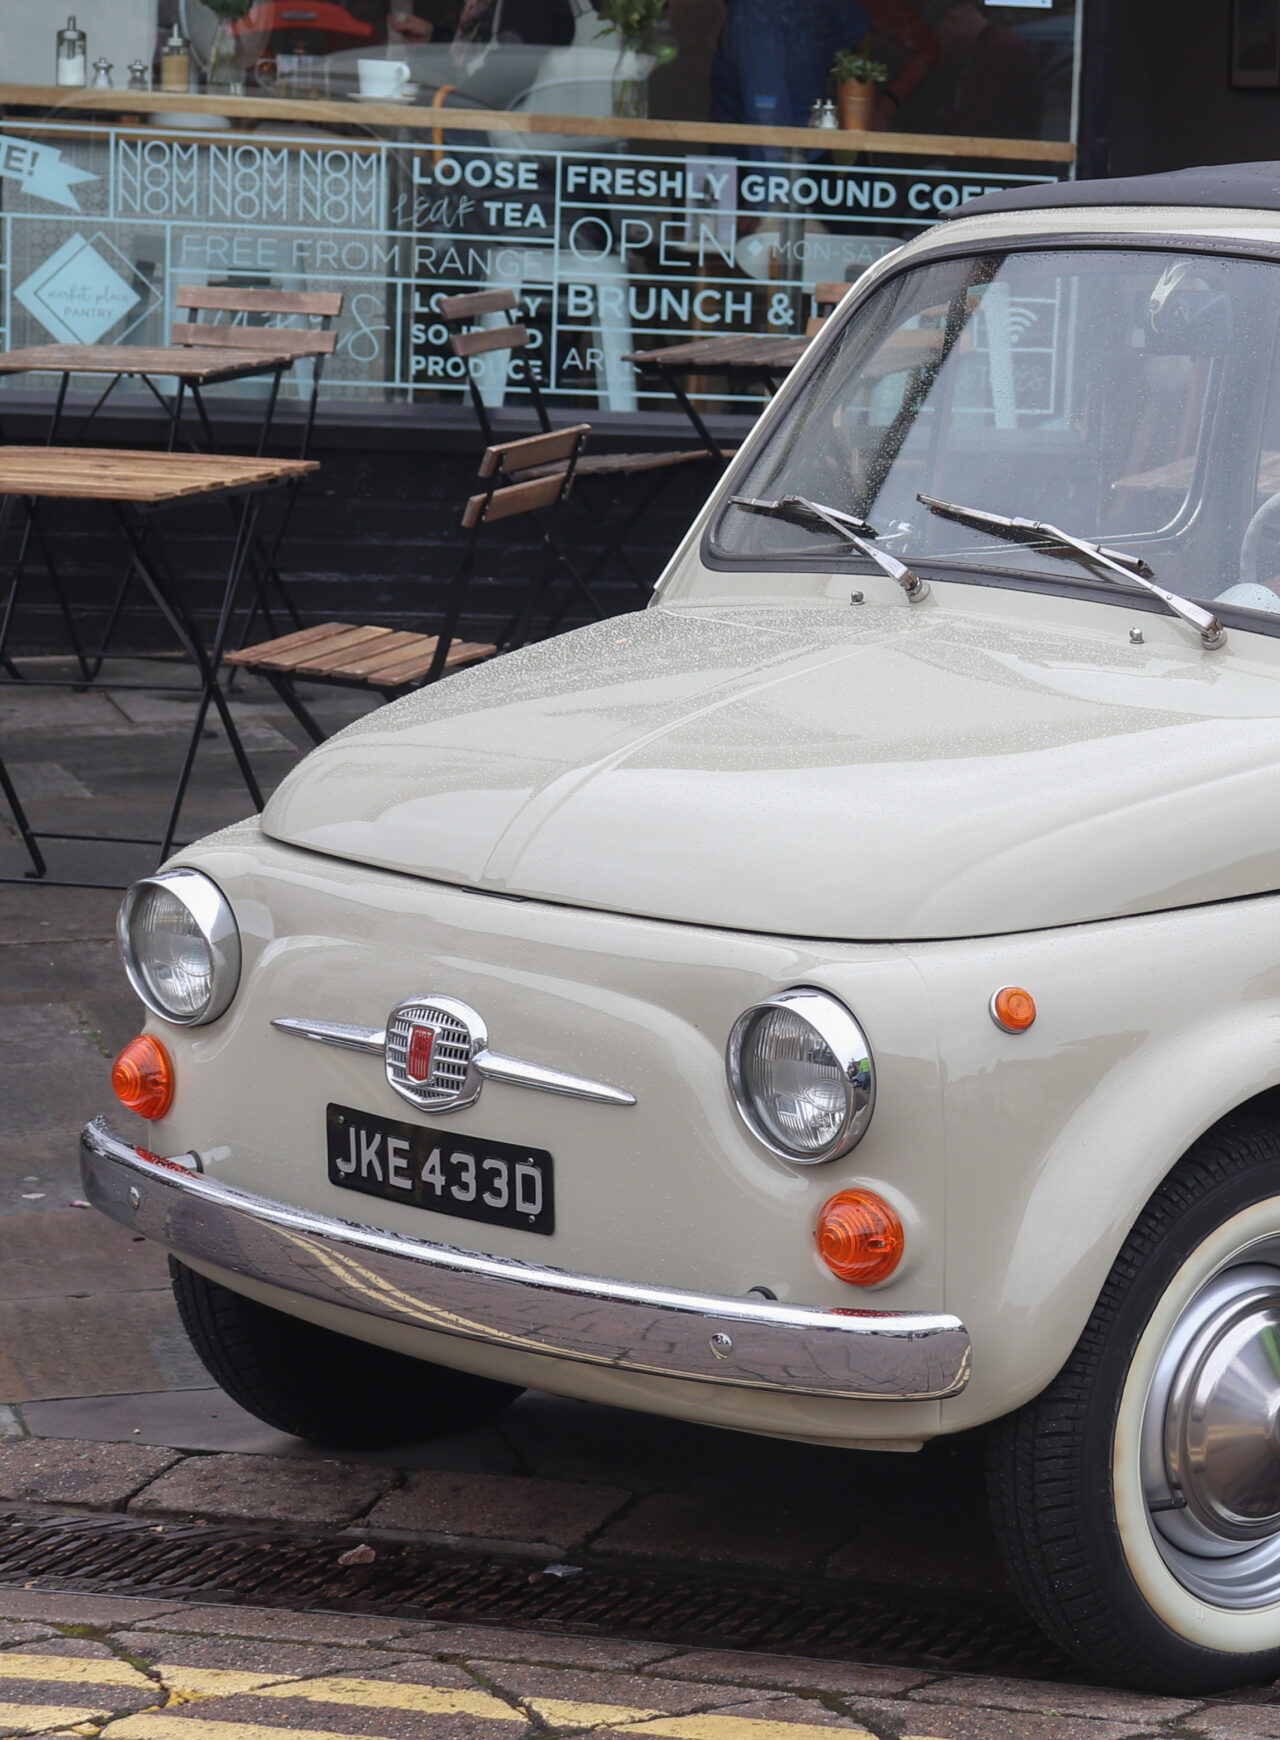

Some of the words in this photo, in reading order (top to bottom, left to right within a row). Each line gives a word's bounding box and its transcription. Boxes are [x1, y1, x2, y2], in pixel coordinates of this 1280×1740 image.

[0, 143, 40, 177] E!
[118, 139, 198, 168] NOM
[210, 144, 288, 172] NOM
[300, 149, 377, 178] NOM
[412, 157, 539, 190] LOOSE
[117, 186, 197, 216] NOM
[209, 192, 287, 220] NOM
[299, 197, 377, 225] NOM
[566, 165, 730, 200] FRESHLY
[740, 174, 897, 209] GROUND
[908, 182, 1003, 211] COF
[483, 201, 548, 229] TEA
[181, 235, 278, 266] FREE
[292, 239, 399, 272] FROM
[414, 245, 544, 279] RANGE
[568, 216, 736, 269] OPEN
[771, 240, 889, 263] MON-SAT
[64, 307, 113, 318] PANTRY
[567, 284, 753, 325] BRUNCH
[767, 292, 795, 326] &
[411, 355, 543, 381] PRODUCE
